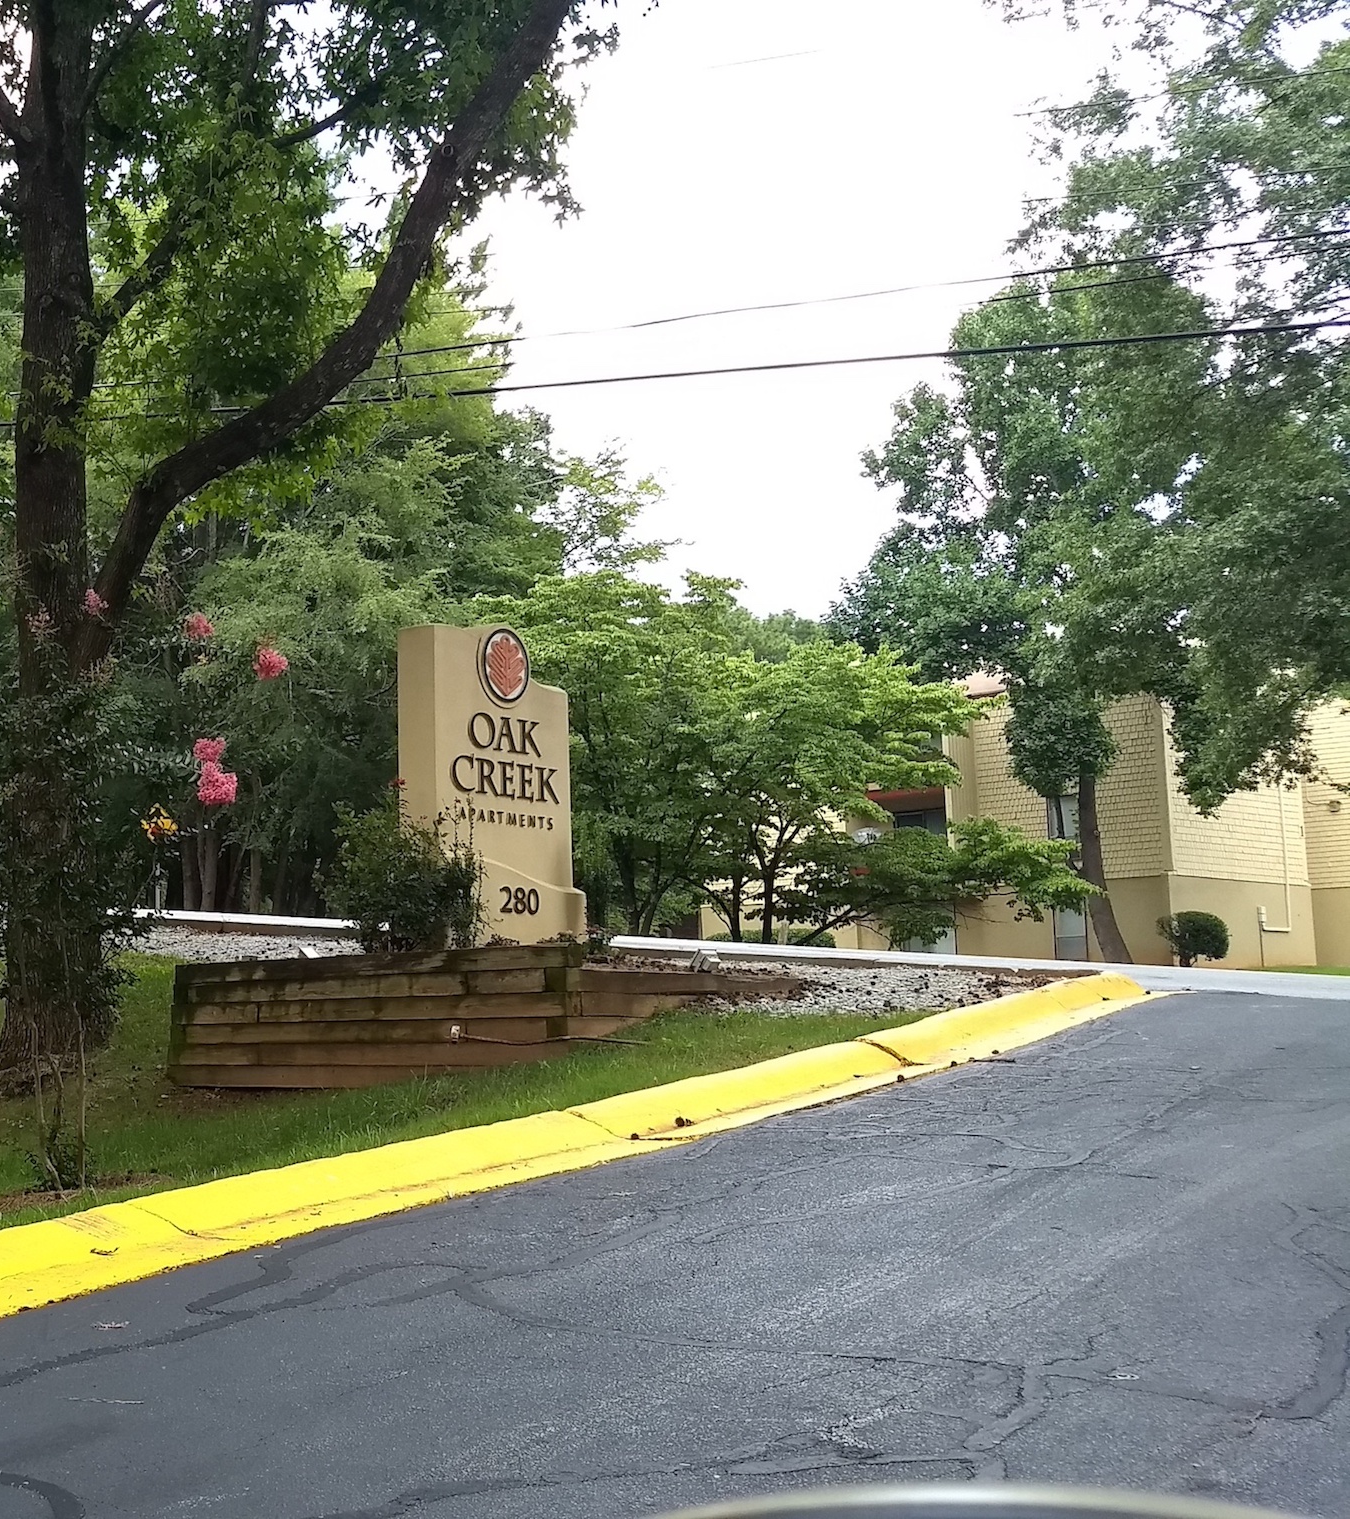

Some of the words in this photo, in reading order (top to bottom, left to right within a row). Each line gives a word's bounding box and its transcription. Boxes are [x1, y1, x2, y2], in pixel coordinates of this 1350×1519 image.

[468, 712, 541, 758] OAK
[450, 754, 559, 805] CREEK
[459, 806, 554, 831] APARTMENTS
[499, 886, 540, 915] 280
